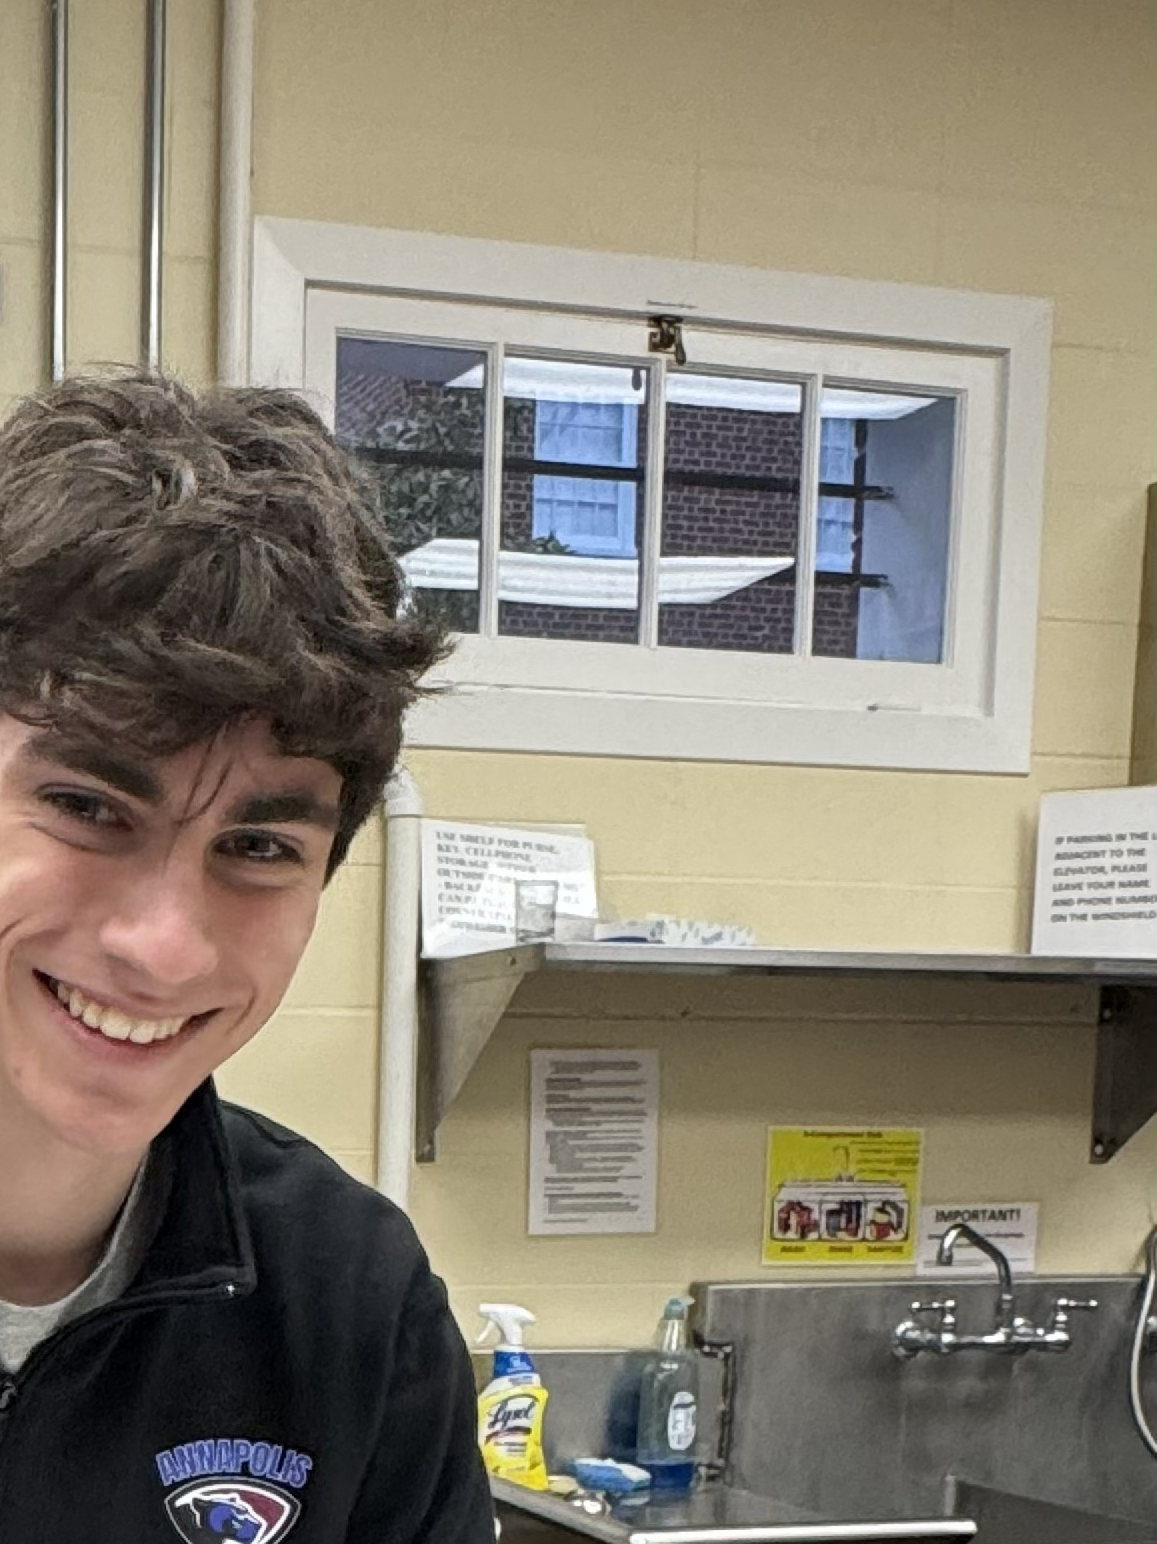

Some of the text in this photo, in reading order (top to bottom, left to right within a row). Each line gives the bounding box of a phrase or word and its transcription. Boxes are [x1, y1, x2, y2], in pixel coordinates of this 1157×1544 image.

[498, 838, 520, 849] FOR
[1067, 834, 1113, 844] PARKING
[1115, 834, 1127, 842] IN
[1130, 832, 1150, 841] THE
[1055, 848, 1146, 860] ADJACENT TO THE
[1111, 864, 1148, 873] PLEASE
[1053, 883, 1084, 892] LEAVE
[1087, 882, 1116, 890] YOUR
[1052, 899, 1075, 907] AND
[1077, 898, 1113, 906] PHONE
[1051, 914, 1068, 923] ON
[1069, 914, 1088, 922] THE
[935, 1208, 1022, 1223] IMPORTANT!
[488, 1400, 536, 1430] Lysol
[155, 1438, 313, 1488] ANNAPOLIS
